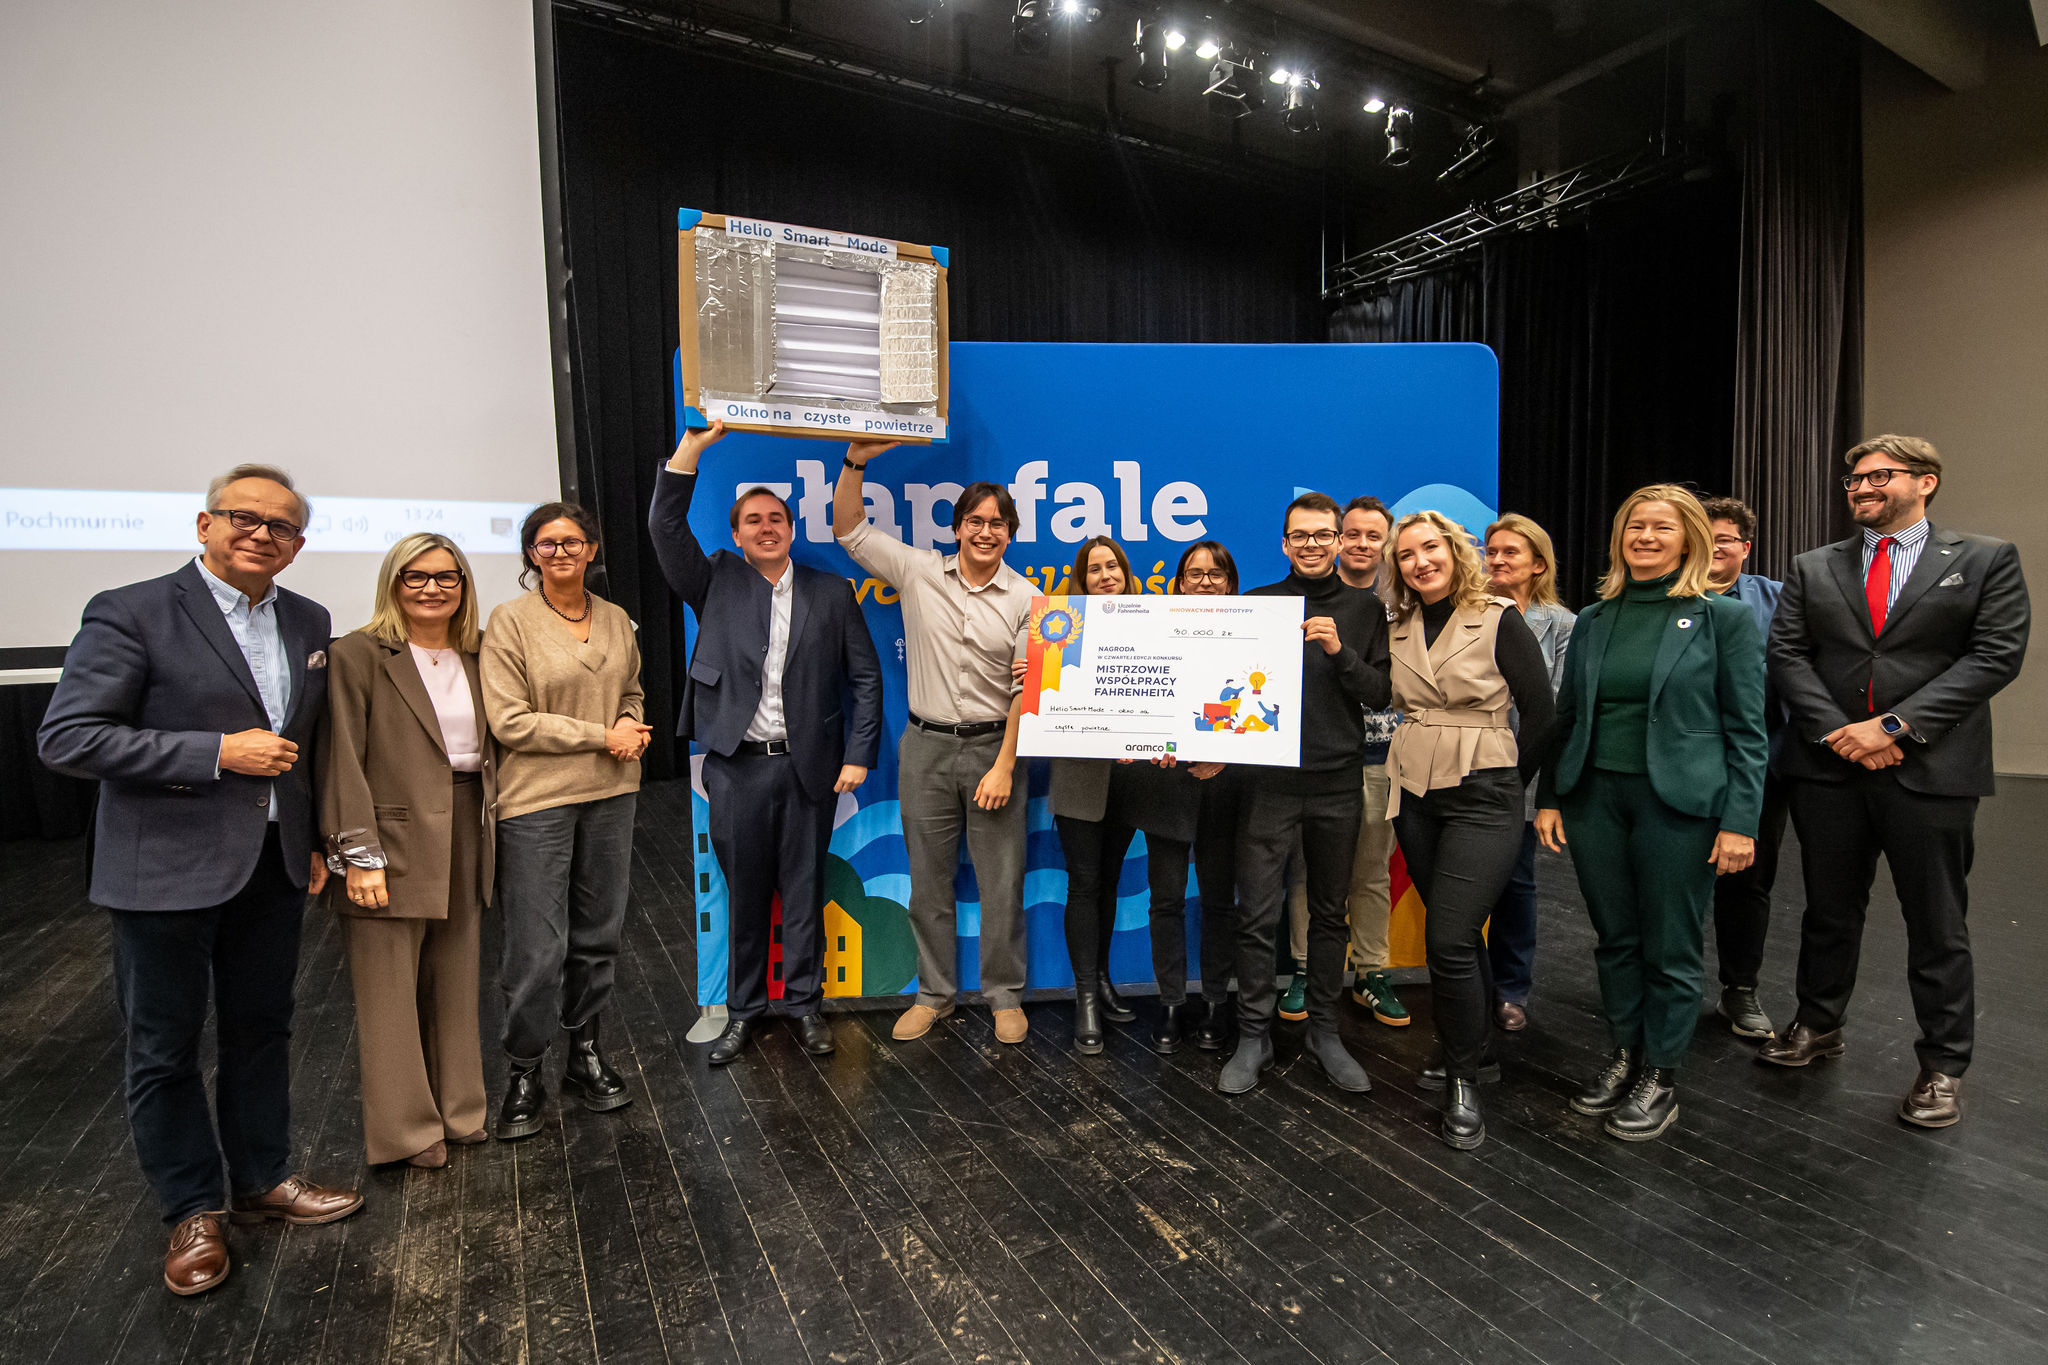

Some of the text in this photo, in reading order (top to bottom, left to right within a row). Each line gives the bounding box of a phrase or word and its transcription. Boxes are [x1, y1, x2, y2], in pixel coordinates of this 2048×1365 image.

[729, 219, 888, 254] Helio Smart Mode
[727, 404, 934, 434] Okno na czyste powietrze
[1007, 460, 1208, 543] fale
[5, 511, 144, 529] Pochmurnie
[1096, 665, 1170, 674] MISTRZOWIE
[1095, 675, 1177, 686] WSPÓŁPRACY
[1094, 687, 1175, 698] FAHRENHEITA
[1125, 744, 1165, 752] aramco
